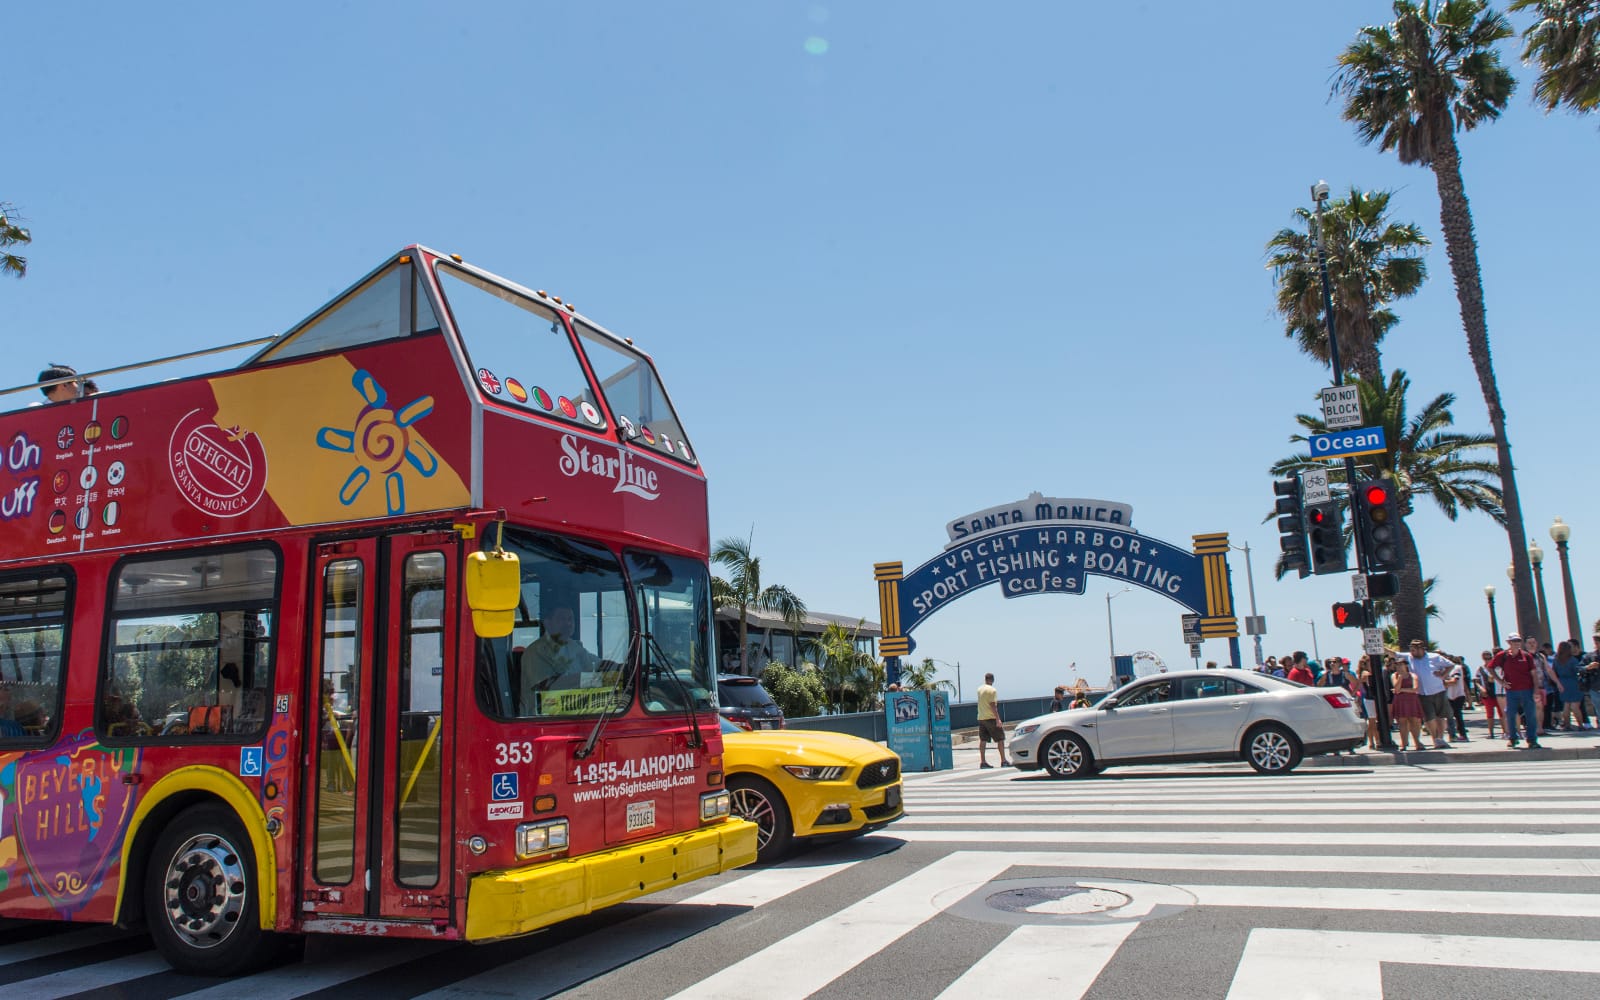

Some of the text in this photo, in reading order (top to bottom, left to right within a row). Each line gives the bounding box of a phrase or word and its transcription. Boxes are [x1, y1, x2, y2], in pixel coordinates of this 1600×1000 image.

[1325, 390, 1356, 403] DO NOT
[1326, 403, 1358, 416] BLOCK
[1327, 415, 1360, 425] INTERSECTION
[9, 435, 40, 469] On
[1316, 433, 1380, 452] Ocean
[189, 436, 246, 486] OFFICIAL
[174, 451, 248, 511] OF SANTA MONICA
[1306, 490, 1328, 500] SIGNAL
[54, 496, 67, 507] 中文
[952, 503, 1122, 540] SANTA MONICA
[945, 530, 1141, 569] YACHT HARBOR
[912, 550, 1182, 615] SPORT FISHING BOATING
[277, 699, 287, 711] 45
[560, 694, 590, 711] YELLOW
[495, 742, 533, 765] 353
[25, 749, 123, 805] BEVERLY
[574, 752, 694, 785] 1-855-4LAHOPON
[573, 774, 695, 803] www.CitySightseeingLA.com
[36, 795, 105, 840] HILLS
